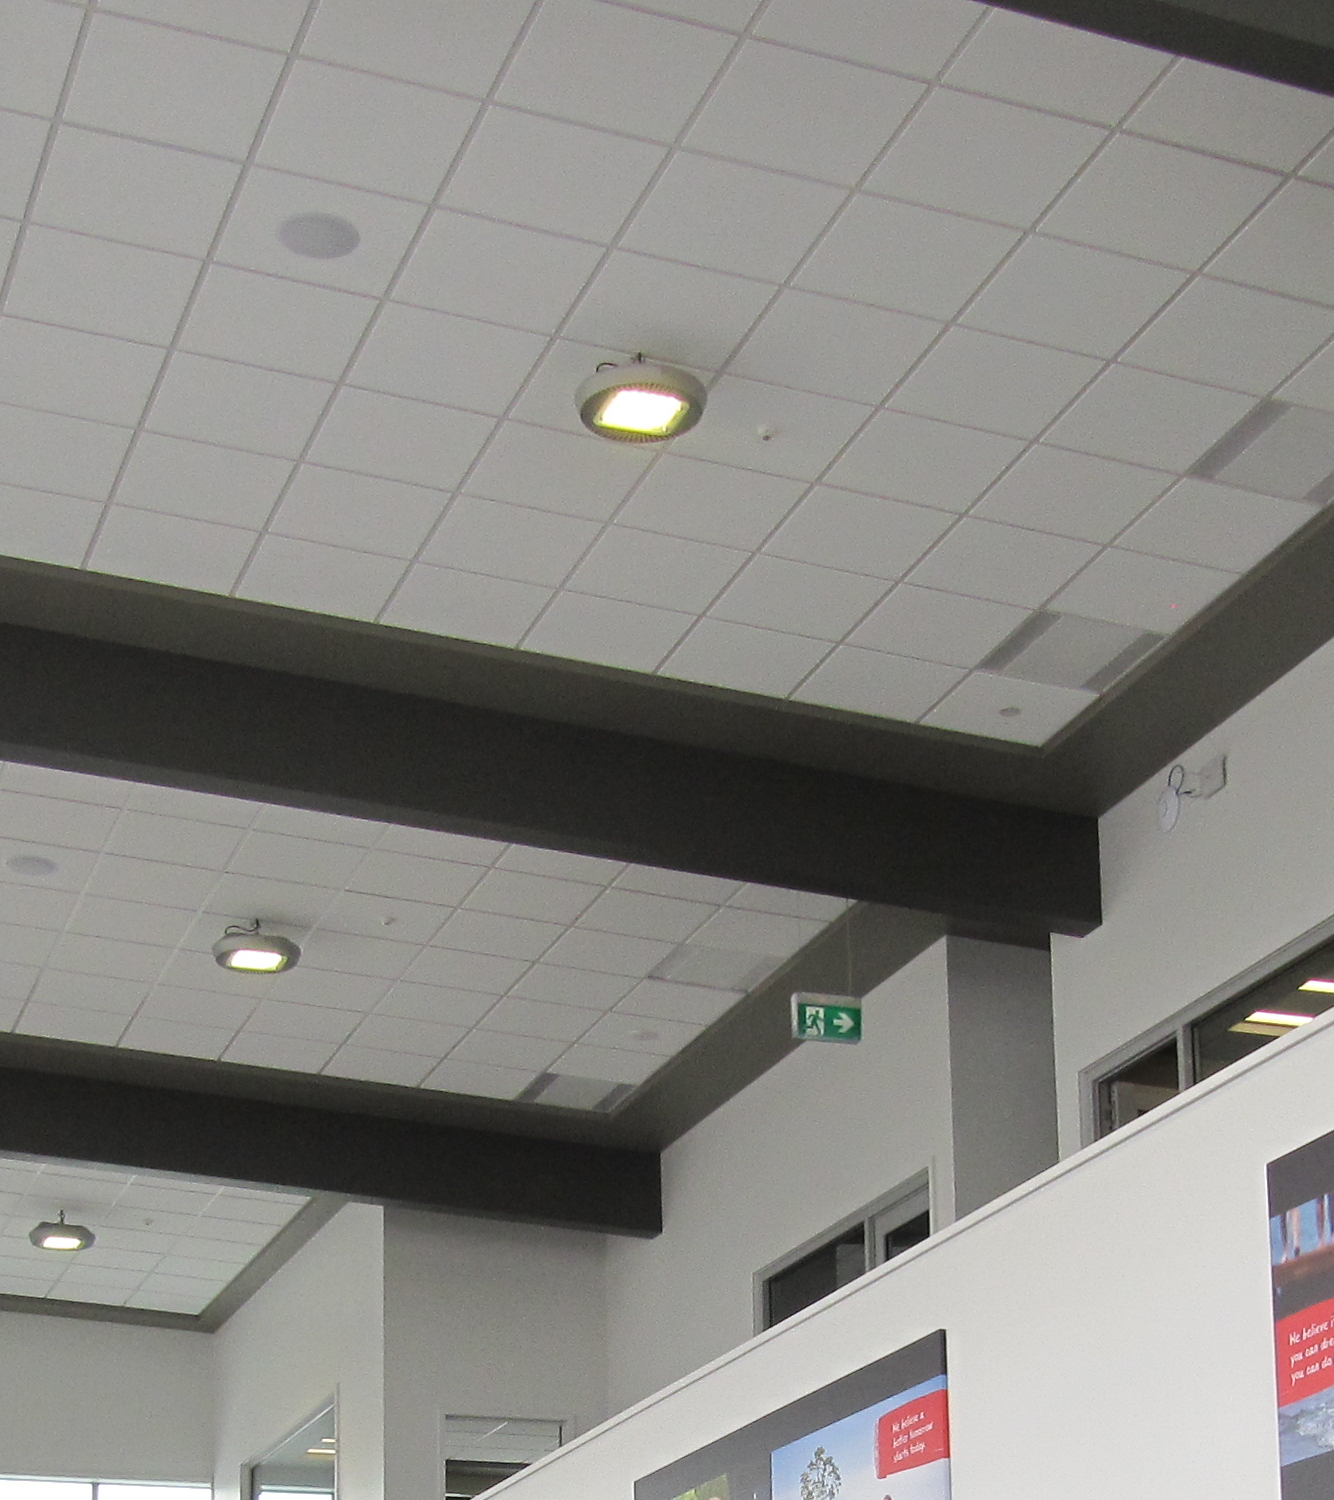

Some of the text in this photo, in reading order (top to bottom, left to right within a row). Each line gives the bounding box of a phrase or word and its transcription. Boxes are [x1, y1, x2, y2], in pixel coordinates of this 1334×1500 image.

[1289, 1331, 1301, 1346] We
[1302, 1323, 1329, 1340] believe
[1290, 1352, 1303, 1368] you
[1305, 1344, 1318, 1357] can
[1291, 1370, 1304, 1386] you
[1306, 1363, 1320, 1375] can
[1321, 1356, 1333, 1369] do
